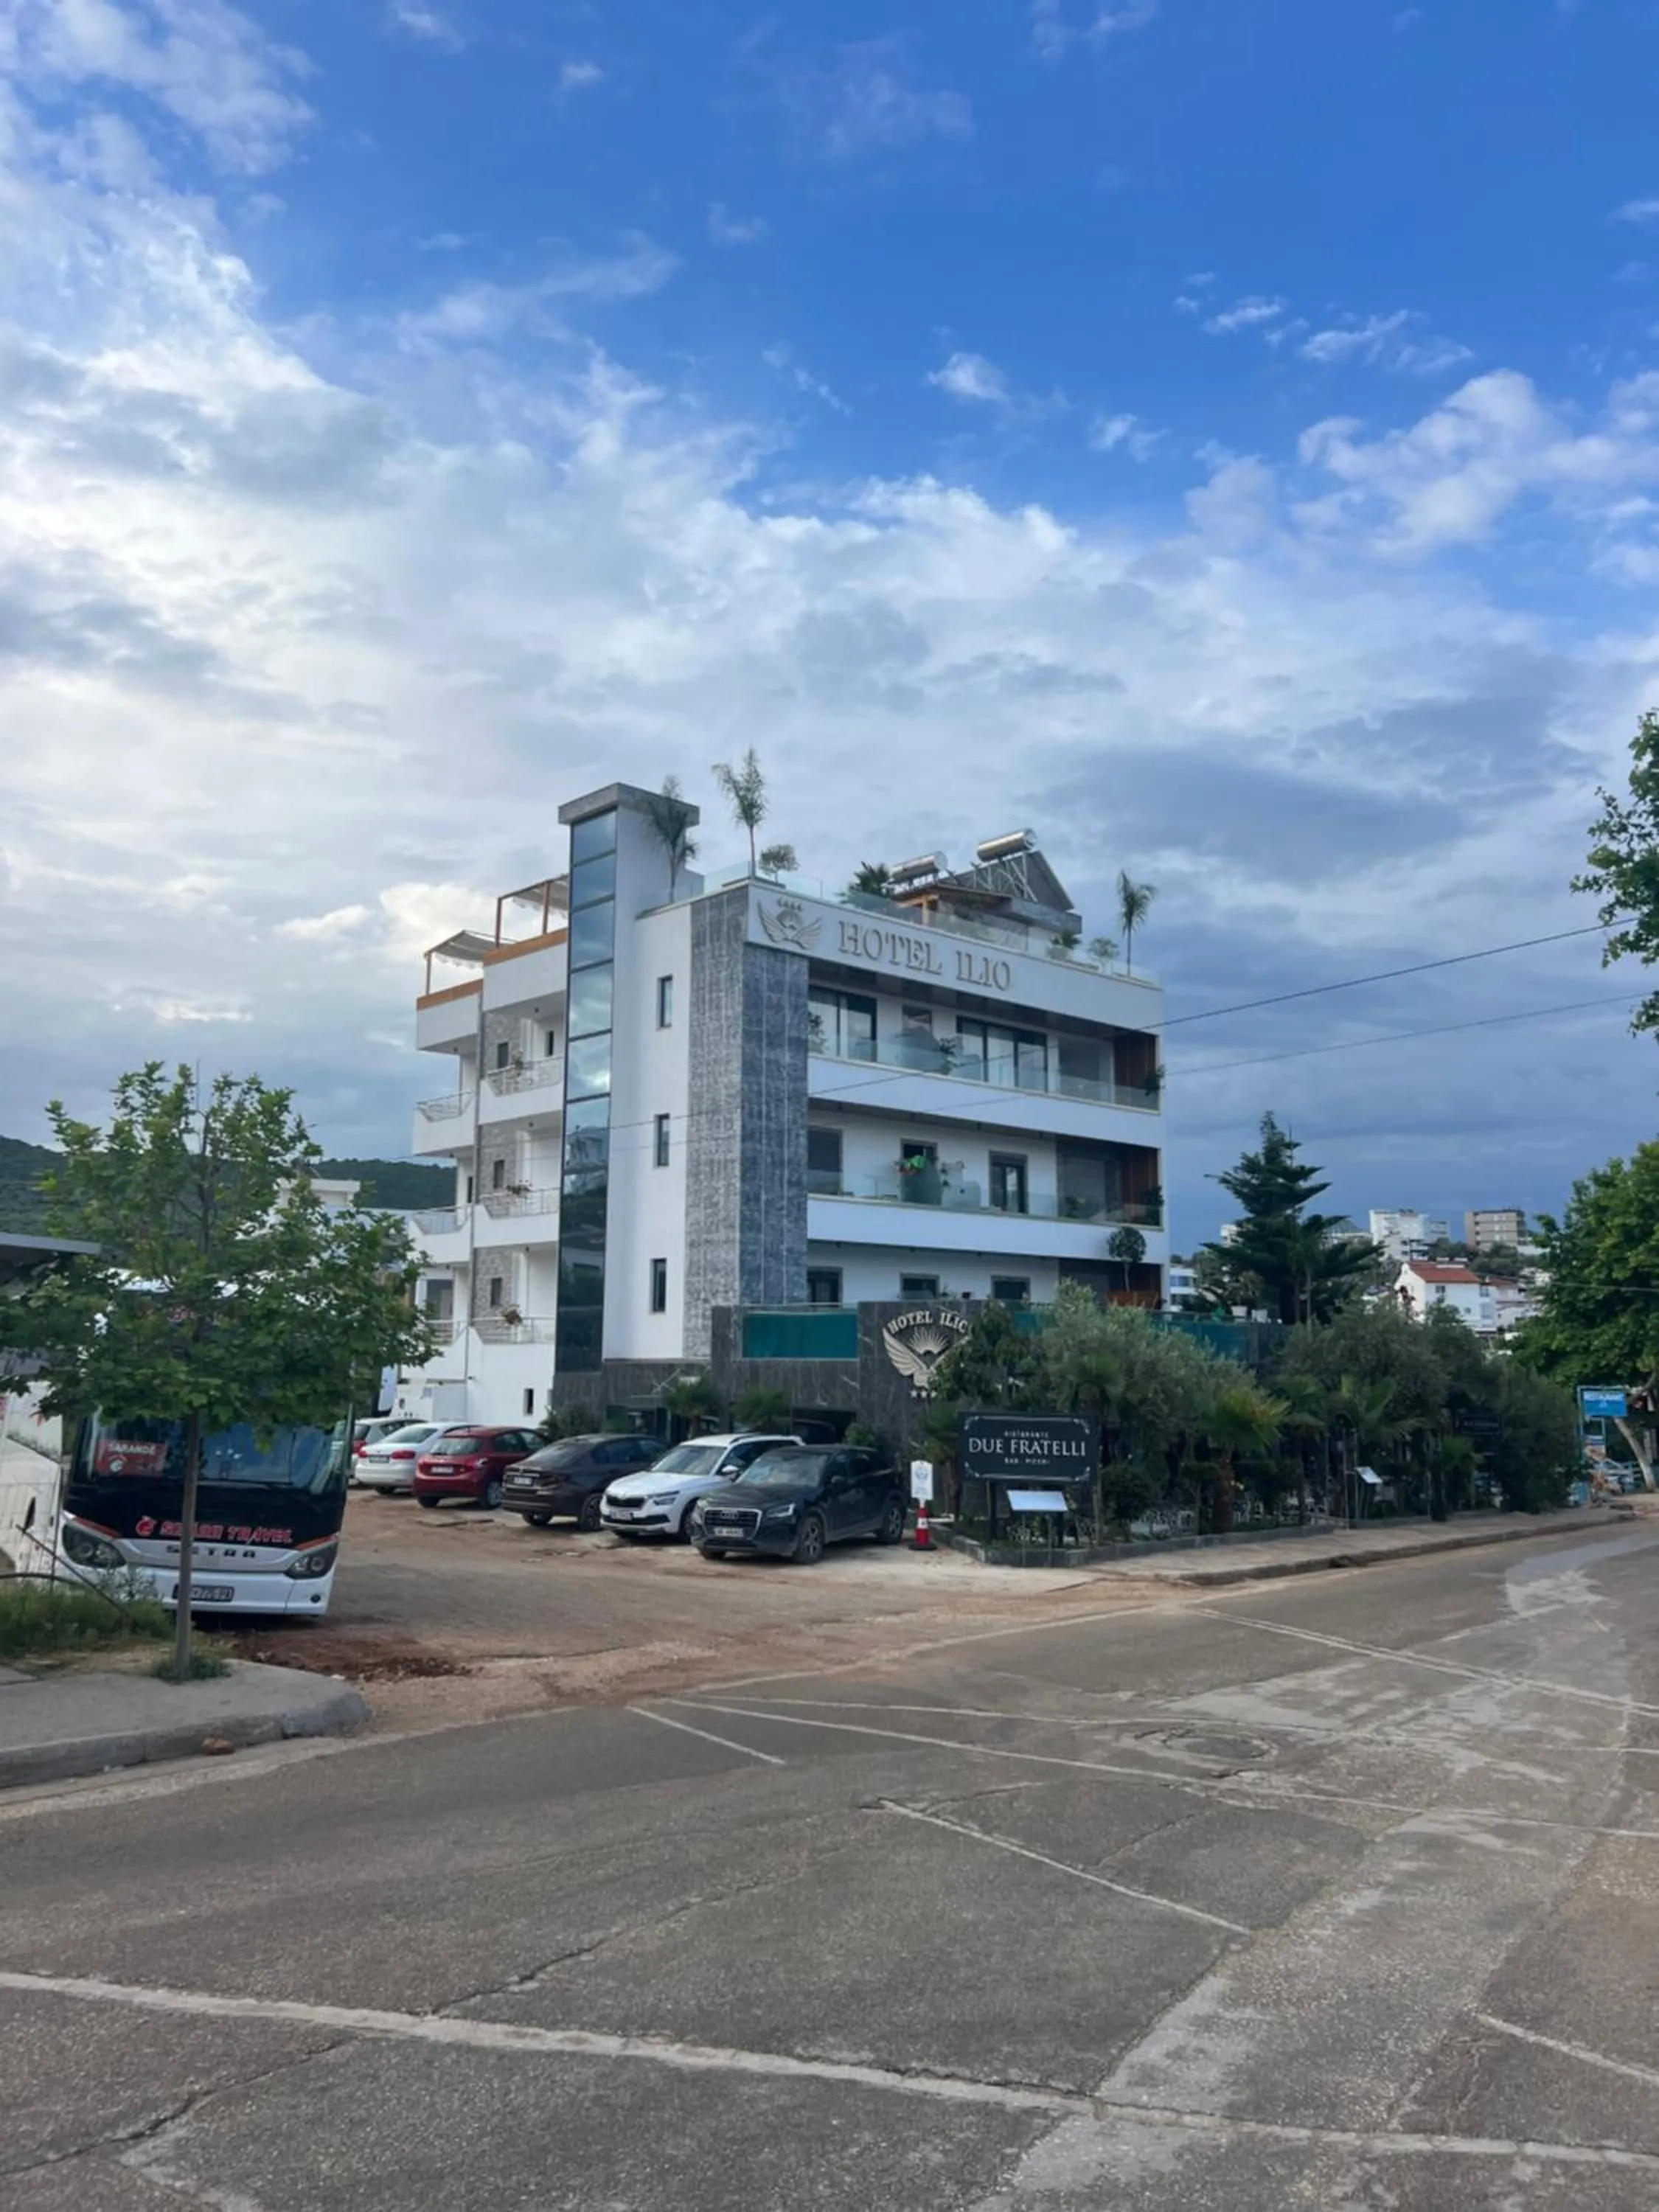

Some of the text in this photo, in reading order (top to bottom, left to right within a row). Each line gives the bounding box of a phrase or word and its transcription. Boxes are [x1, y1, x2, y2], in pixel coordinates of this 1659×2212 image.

[838, 919, 1012, 992] HOTEL ILIO
[887, 1310, 933, 1335] HOTEL
[968, 1437, 1087, 1457] DUE FRATELLI
